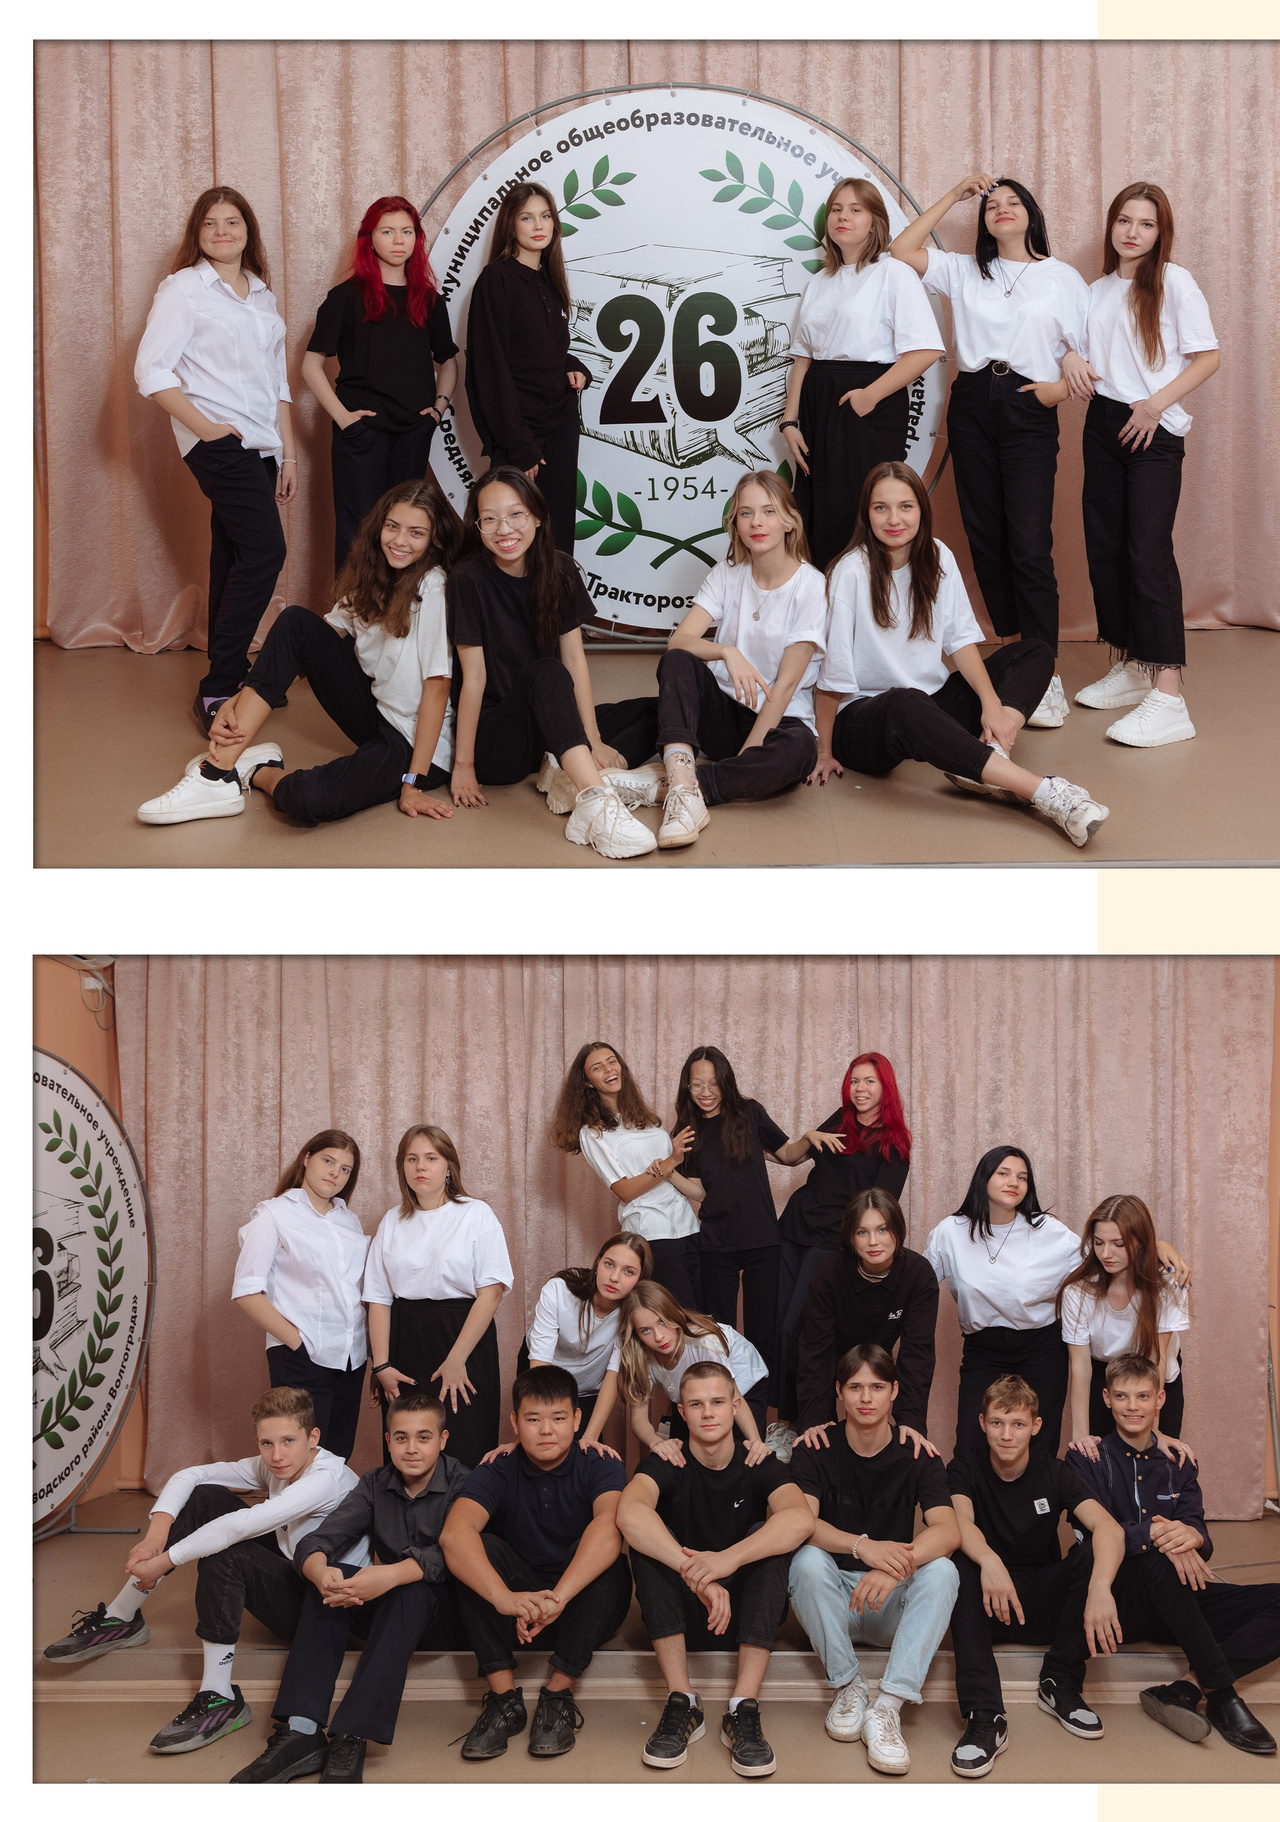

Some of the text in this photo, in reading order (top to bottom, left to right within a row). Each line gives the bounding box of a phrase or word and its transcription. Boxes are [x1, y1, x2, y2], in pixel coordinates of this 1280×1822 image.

[440, 109, 816, 302] муниципальное общеобразовательное
[596, 291, 742, 425] 26
[587, 572, 695, 613] Трактороз
[97, 1129, 136, 1229] учреждение
[81, 1404, 113, 1458] района
[108, 1294, 138, 1400] Волгограда»
